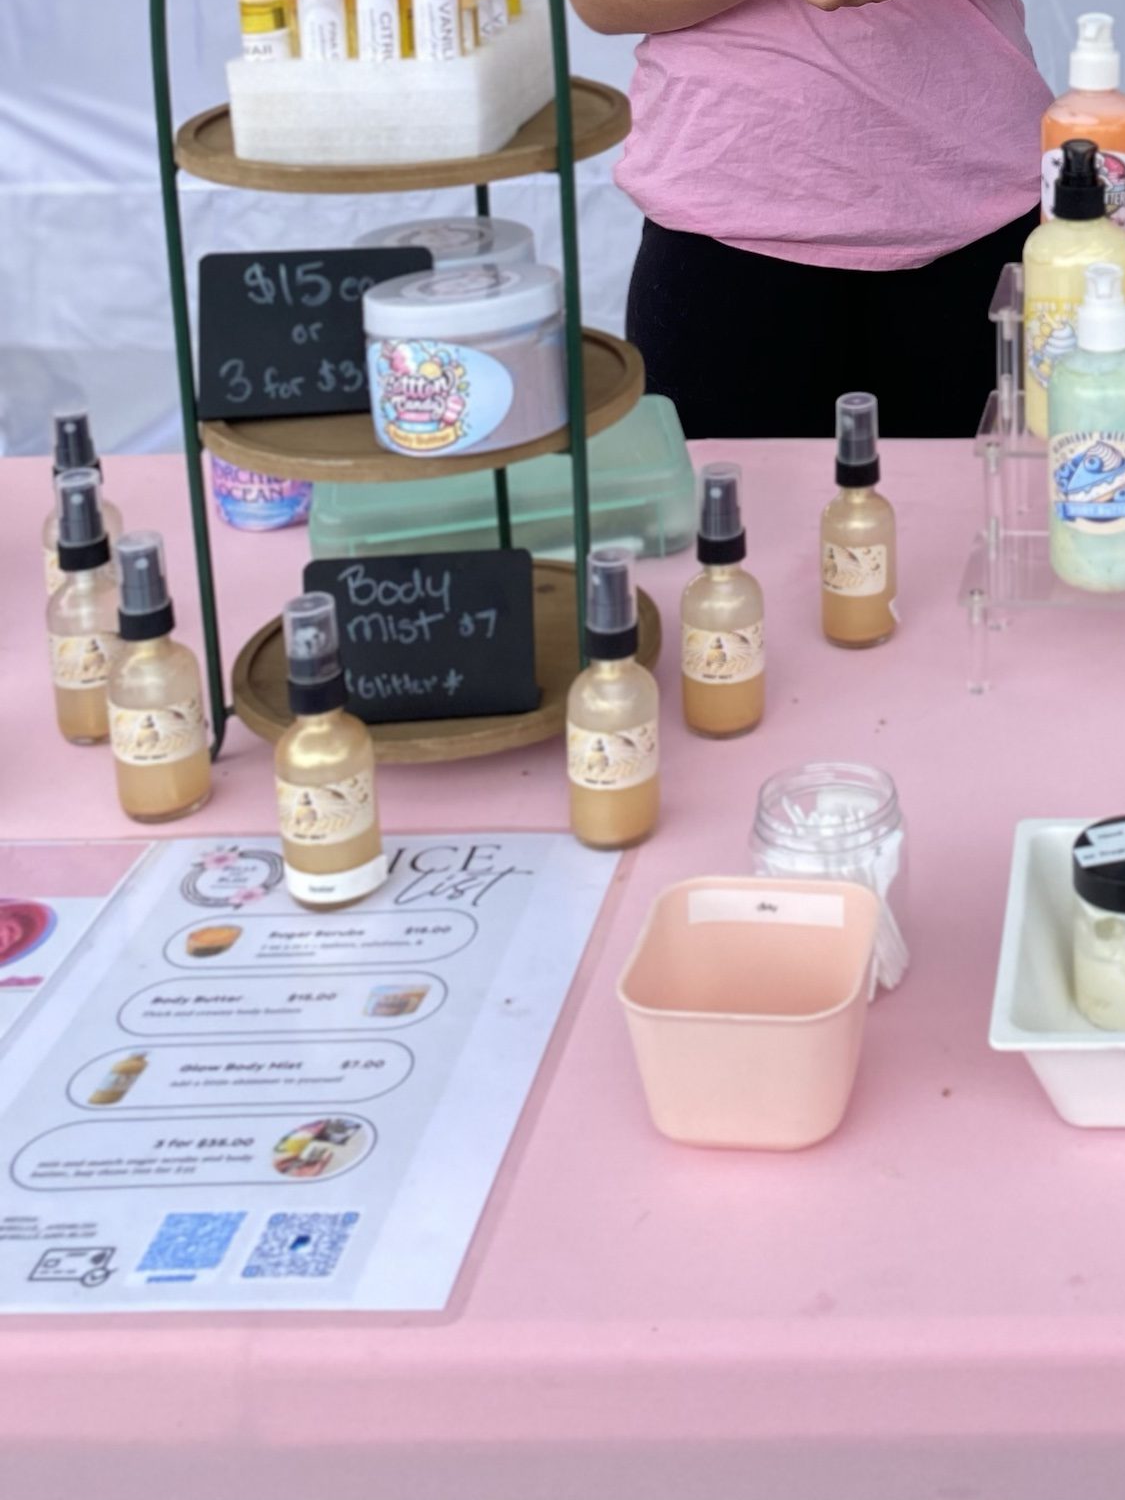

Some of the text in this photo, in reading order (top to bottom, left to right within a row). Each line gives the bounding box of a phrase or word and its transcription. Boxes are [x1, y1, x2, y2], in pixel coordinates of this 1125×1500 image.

[243, 261, 332, 307] $15
[291, 321, 324, 346] or
[218, 357, 370, 404] 3 for $3
[337, 563, 452, 614] Body
[458, 608, 498, 640] $7
